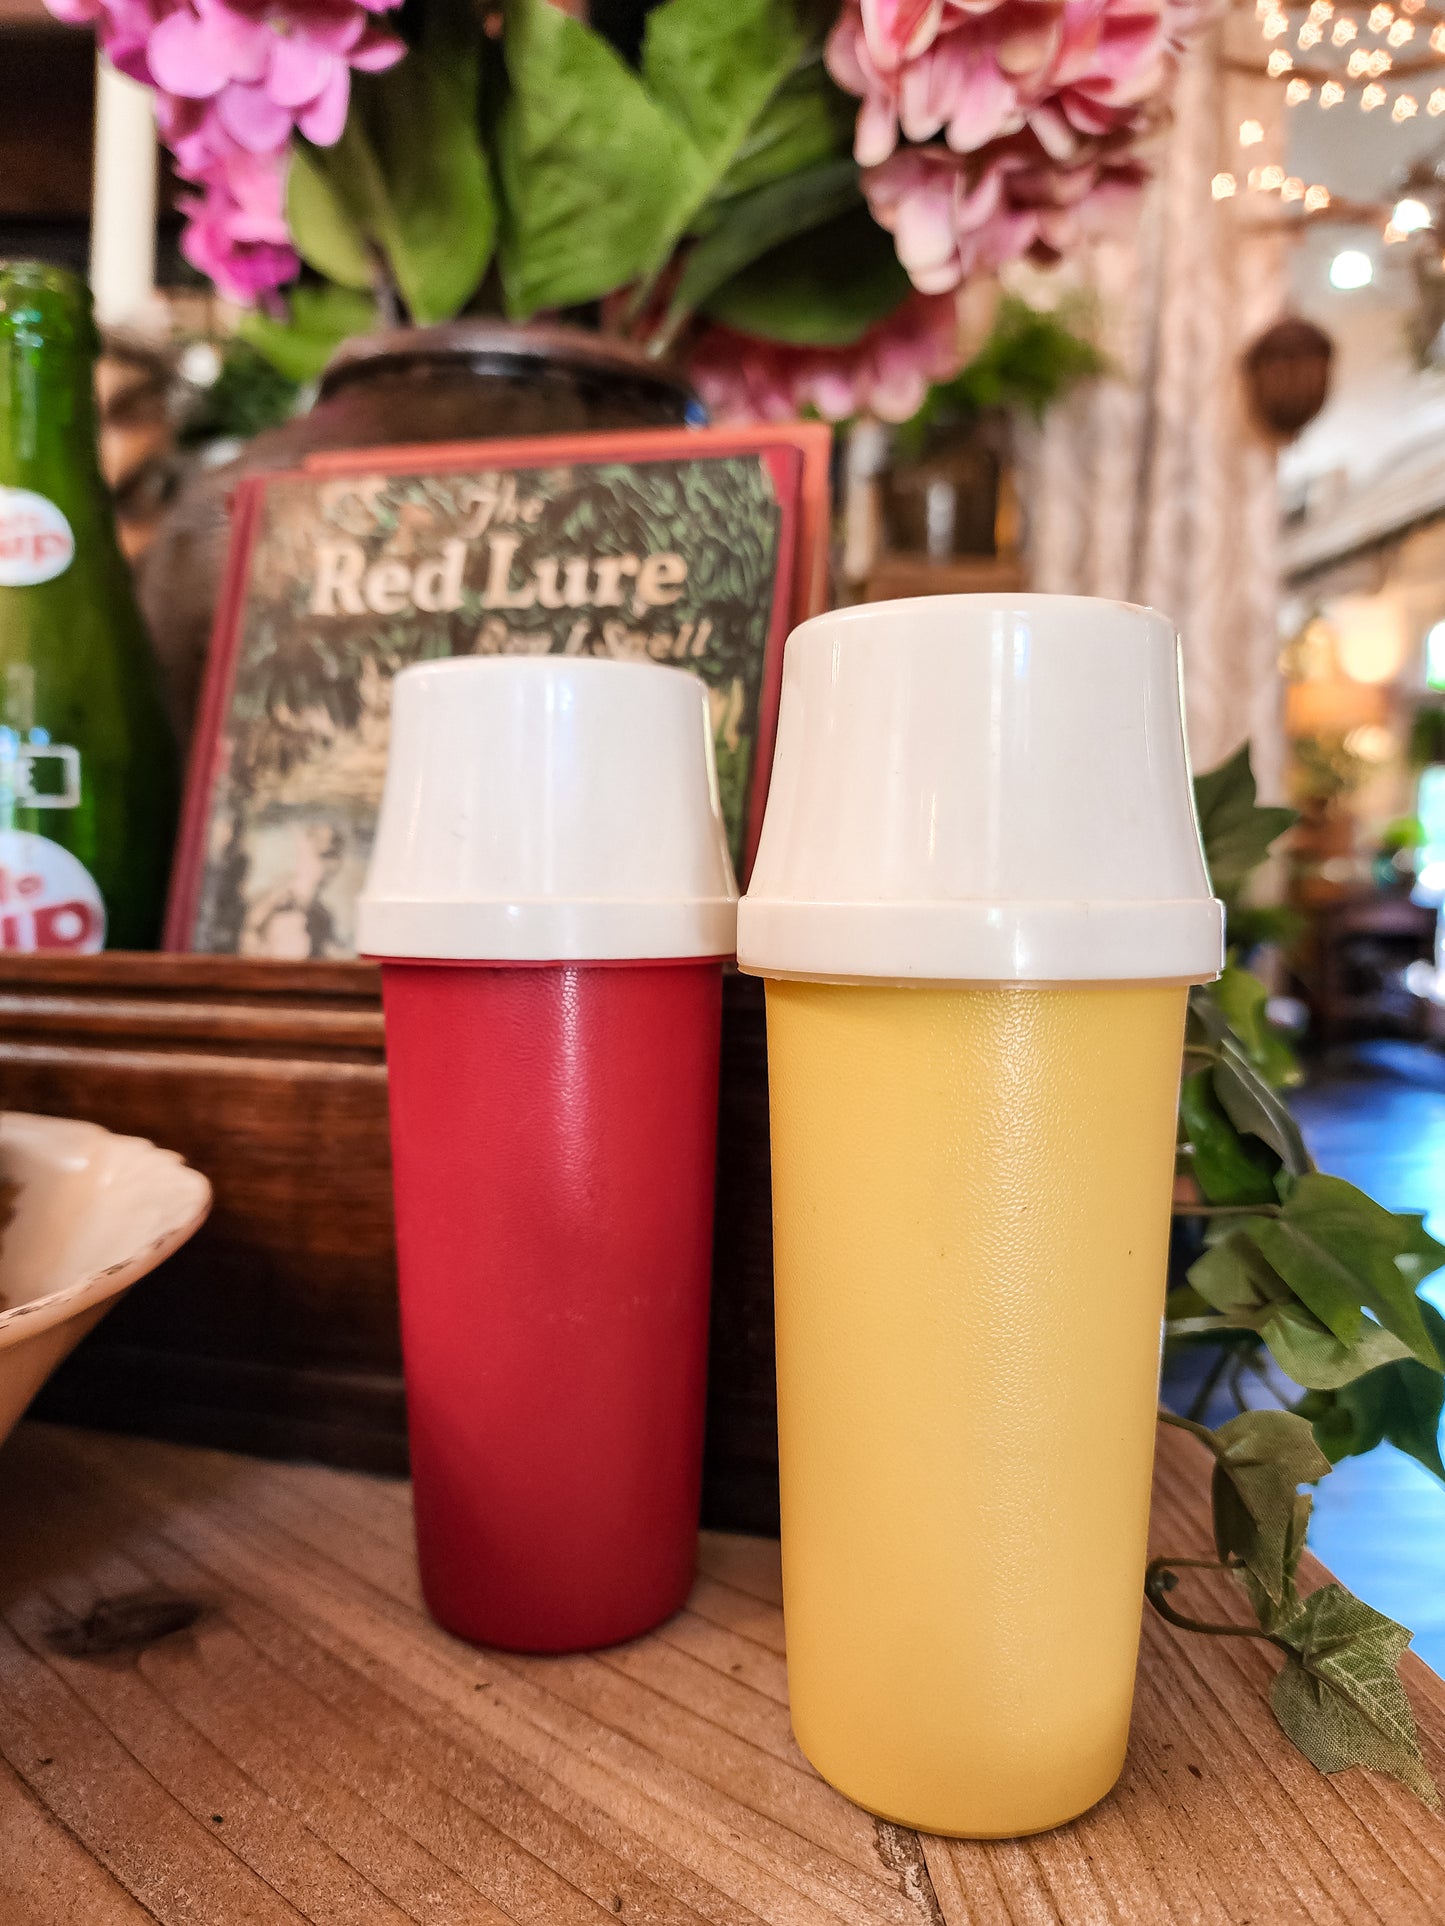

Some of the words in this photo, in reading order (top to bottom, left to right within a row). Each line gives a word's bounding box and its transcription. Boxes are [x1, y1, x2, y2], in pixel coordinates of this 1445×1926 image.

[458, 478, 546, 538] The
[309, 536, 466, 616] Red
[482, 531, 688, 610] Lure
